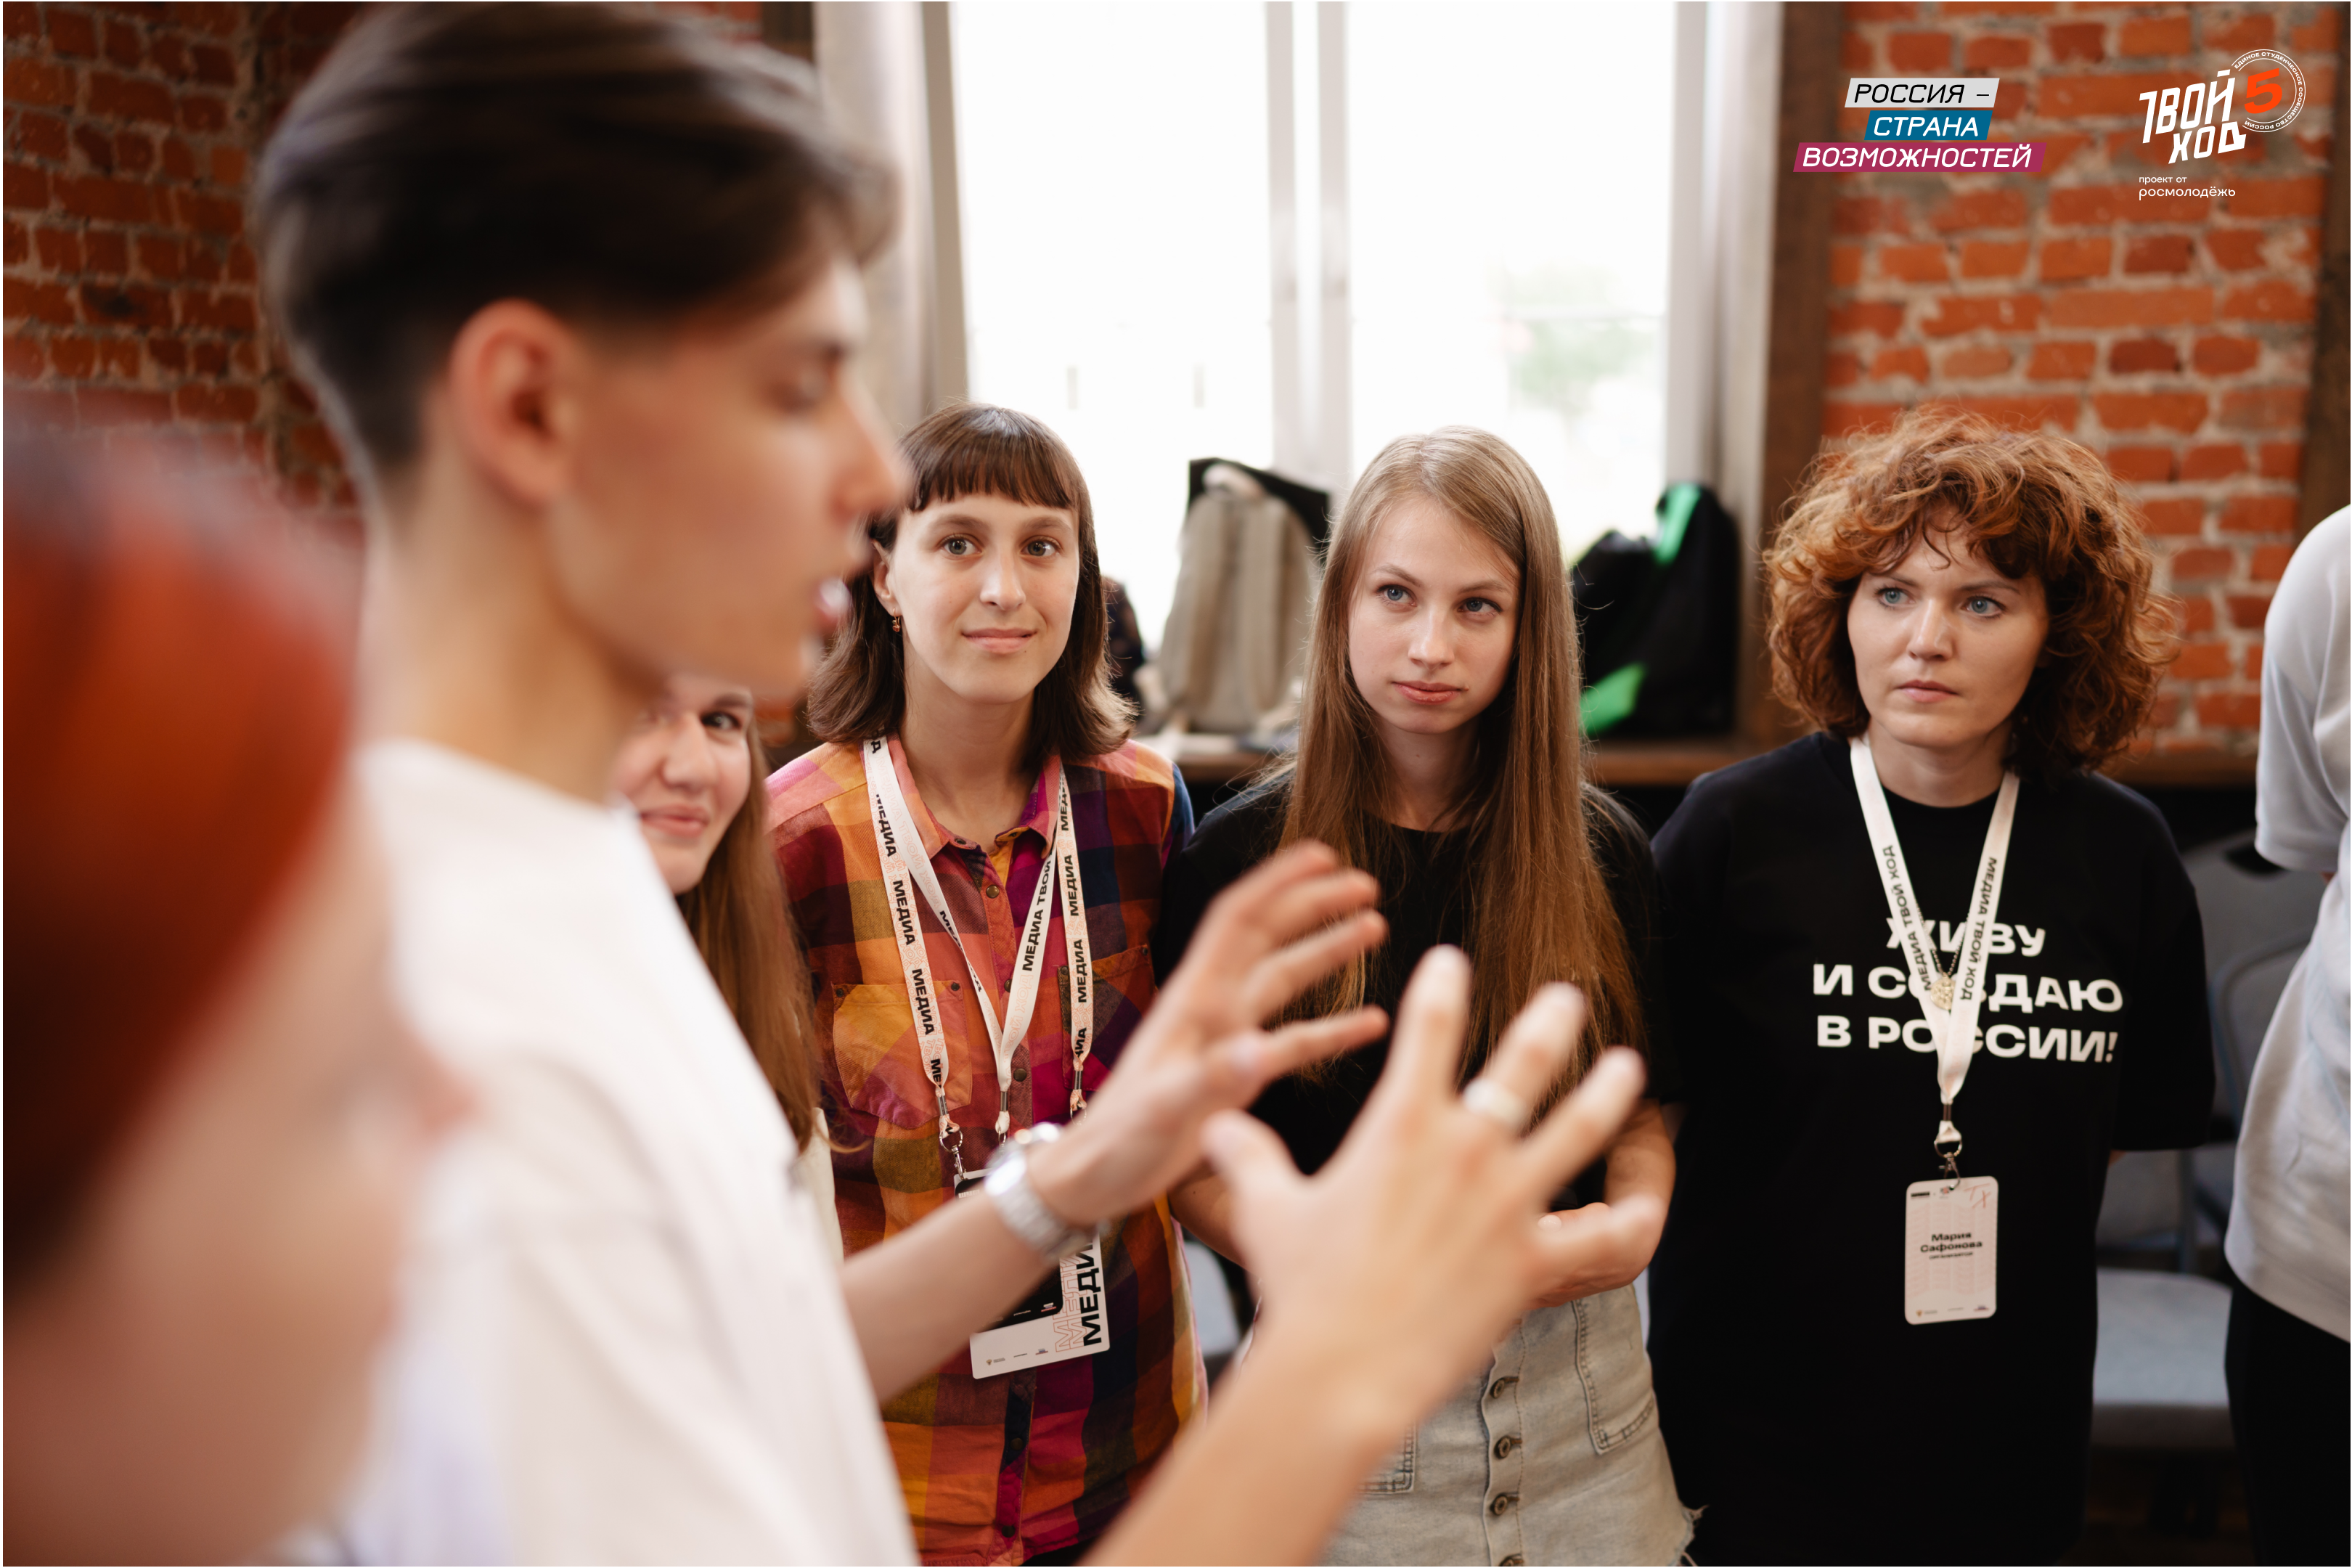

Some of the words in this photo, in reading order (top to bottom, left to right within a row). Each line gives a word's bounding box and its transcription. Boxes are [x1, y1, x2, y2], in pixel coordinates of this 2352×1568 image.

[1064, 854, 1079, 917] МЕДИА
[1882, 844, 1900, 881] ХОД
[1978, 856, 1998, 915] МЕДИА
[892, 879, 916, 946] МЕДИА
[1022, 909, 1044, 972] МЕДИА
[1036, 859, 1052, 906] ТВОЙ
[1890, 883, 1911, 928] ТВОЙ
[1907, 931, 1932, 992] МЕДИА
[1968, 920, 1985, 964] ТВОЙ
[1074, 939, 1087, 1003] МЕДИА
[1813, 963, 1853, 997] И
[1867, 965, 2124, 1013] СДАЮ
[1960, 967, 1977, 1000] ХОД
[912, 968, 935, 1036] МЕДИА
[1817, 1015, 1853, 1048] В
[1920, 1241, 1983, 1252] Сафонова
[1931, 1233, 1972, 1242] Мария
[1075, 1241, 1102, 1347] МЕДИ
